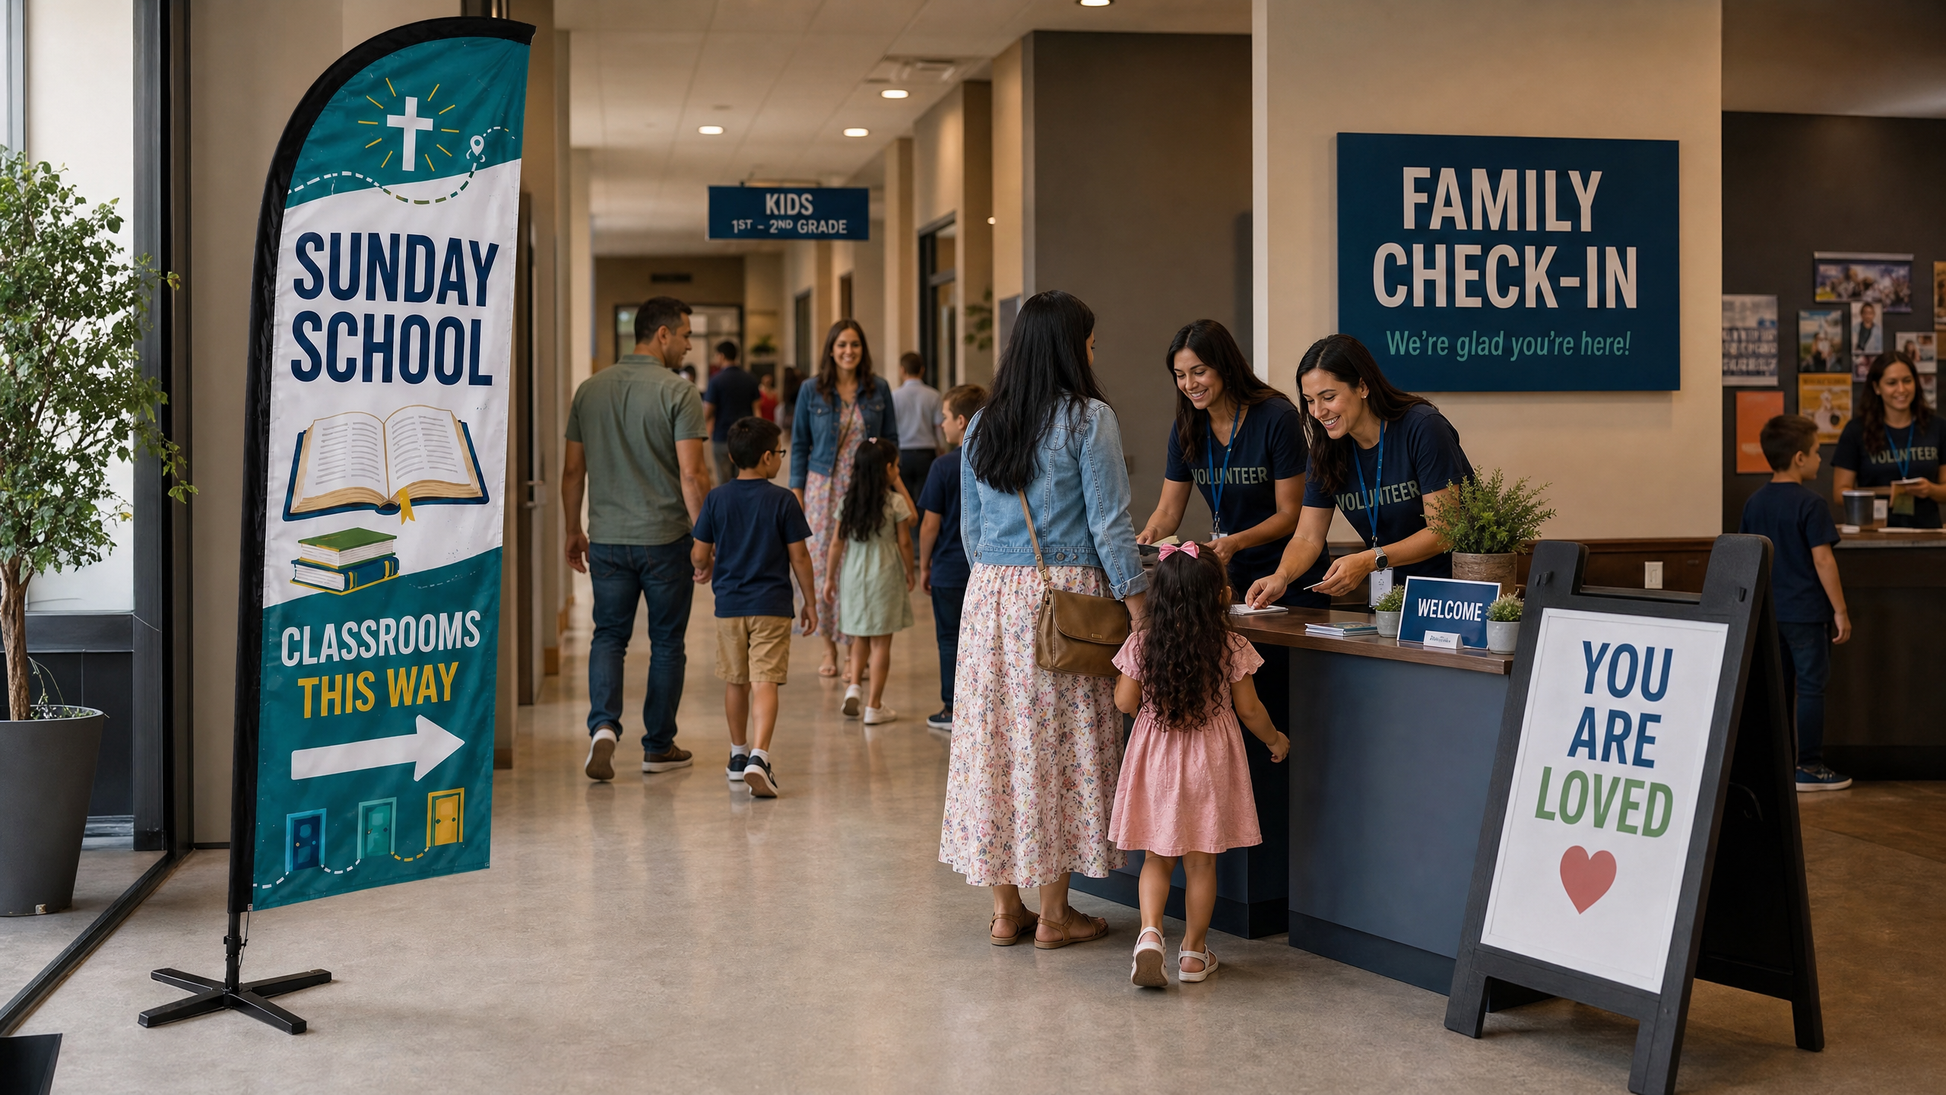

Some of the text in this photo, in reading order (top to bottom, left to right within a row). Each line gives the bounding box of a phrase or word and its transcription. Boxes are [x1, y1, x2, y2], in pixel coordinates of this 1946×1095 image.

[731, 219, 753, 234] 1ST
[769, 219, 794, 234] 2ND
[797, 219, 848, 234] GRADE
[765, 193, 814, 215] KIDS
[1403, 166, 1602, 232] FAMILY
[293, 231, 500, 307] SUNDAY
[1373, 242, 1637, 309] CHECK-IN
[290, 310, 493, 386] SCHOOL
[1386, 330, 1632, 361] We’re glad you’re here!
[1191, 466, 1268, 485] VOLUNTEER
[281, 610, 481, 667] CLASSROOMS
[1418, 598, 1483, 622] WELCOME
[298, 661, 459, 719] THIS WAY
[1582, 640, 1674, 702] YOU
[1567, 706, 1662, 769] ARE
[1535, 766, 1674, 838] LOVED
